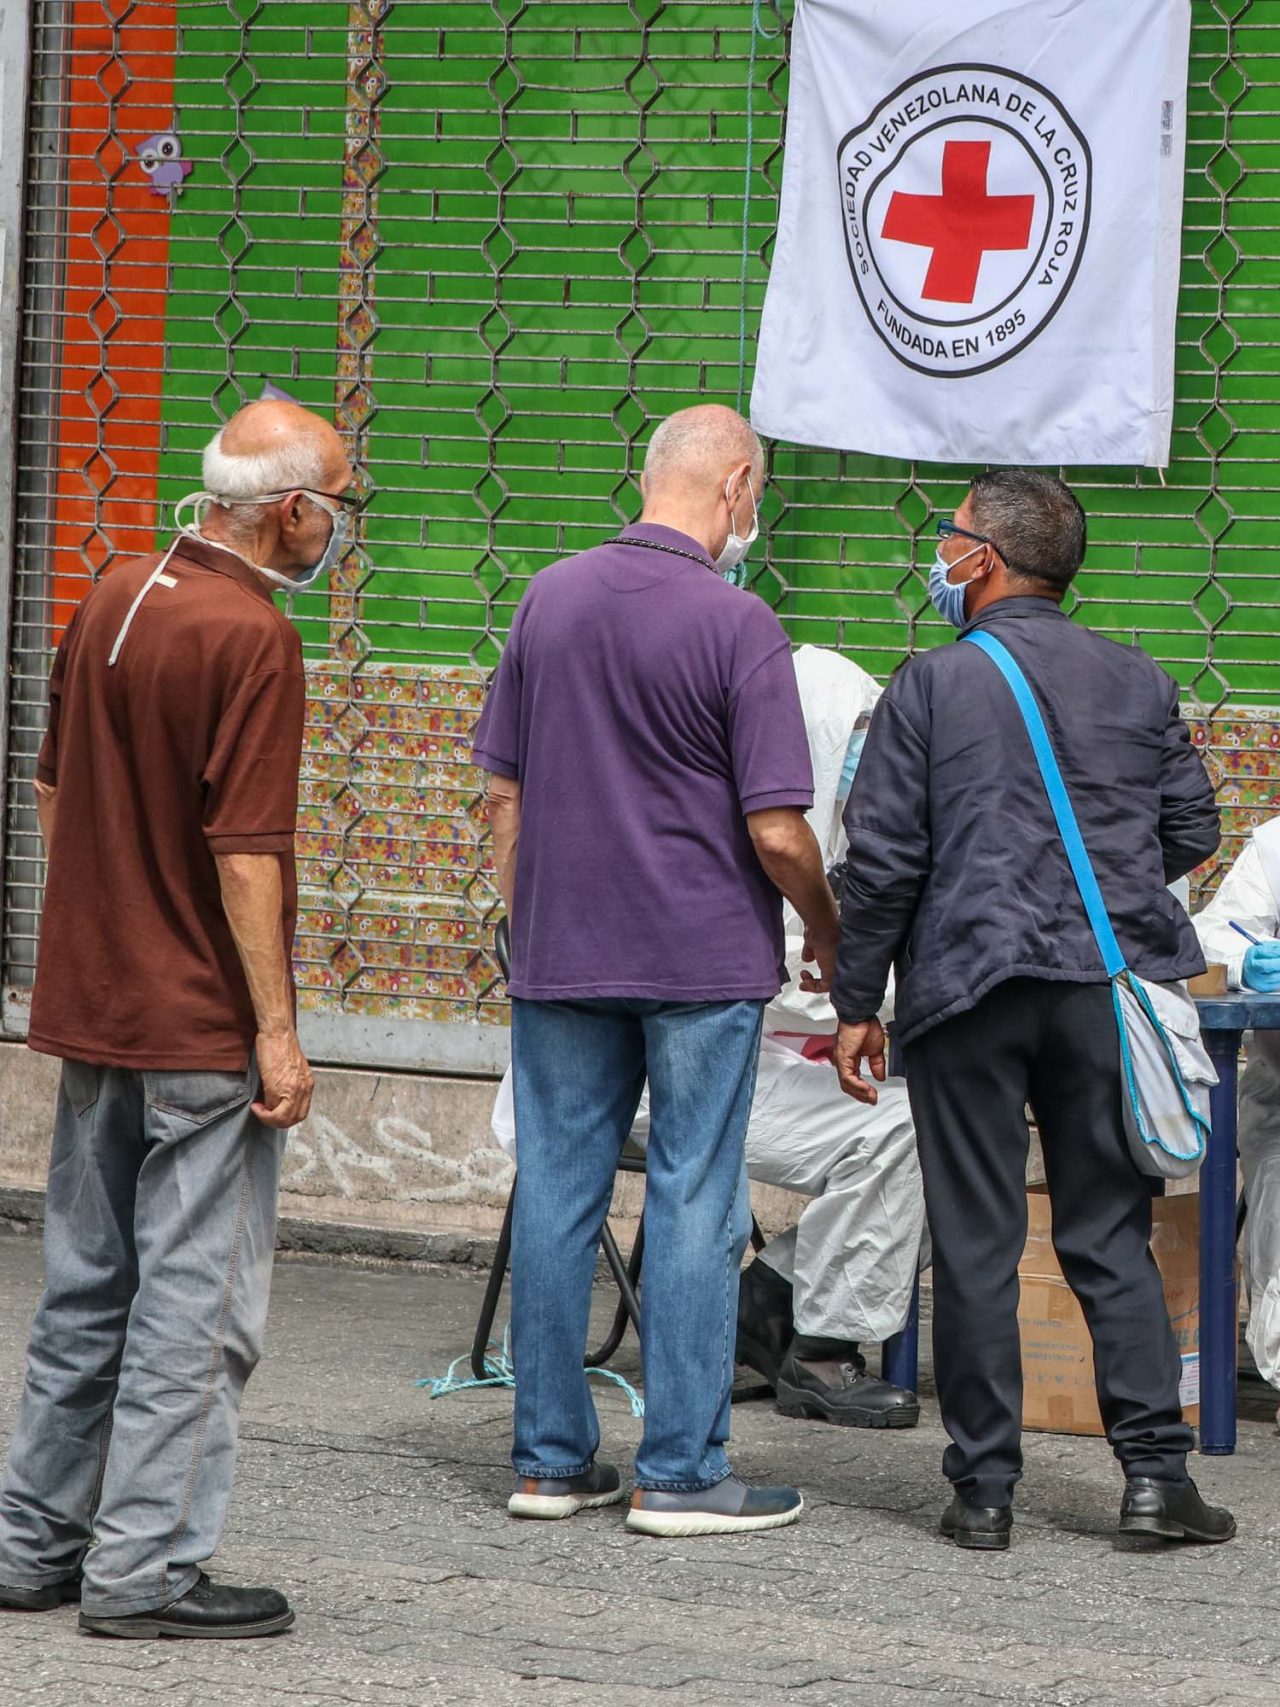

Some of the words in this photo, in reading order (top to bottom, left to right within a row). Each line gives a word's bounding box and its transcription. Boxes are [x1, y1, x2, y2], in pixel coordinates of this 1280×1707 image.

[868, 84, 1001, 154] VENEZOLANA
[1005, 93, 1037, 122] DE
[1034, 115, 1057, 148] LA
[845, 150, 873, 275] SOCIEDAD
[1054, 147, 1079, 214] CRUZ
[1038, 221, 1073, 286] ROJA
[877, 298, 949, 358] FUNDADA
[952, 336, 980, 358] EN
[985, 308, 1026, 347] 1895
